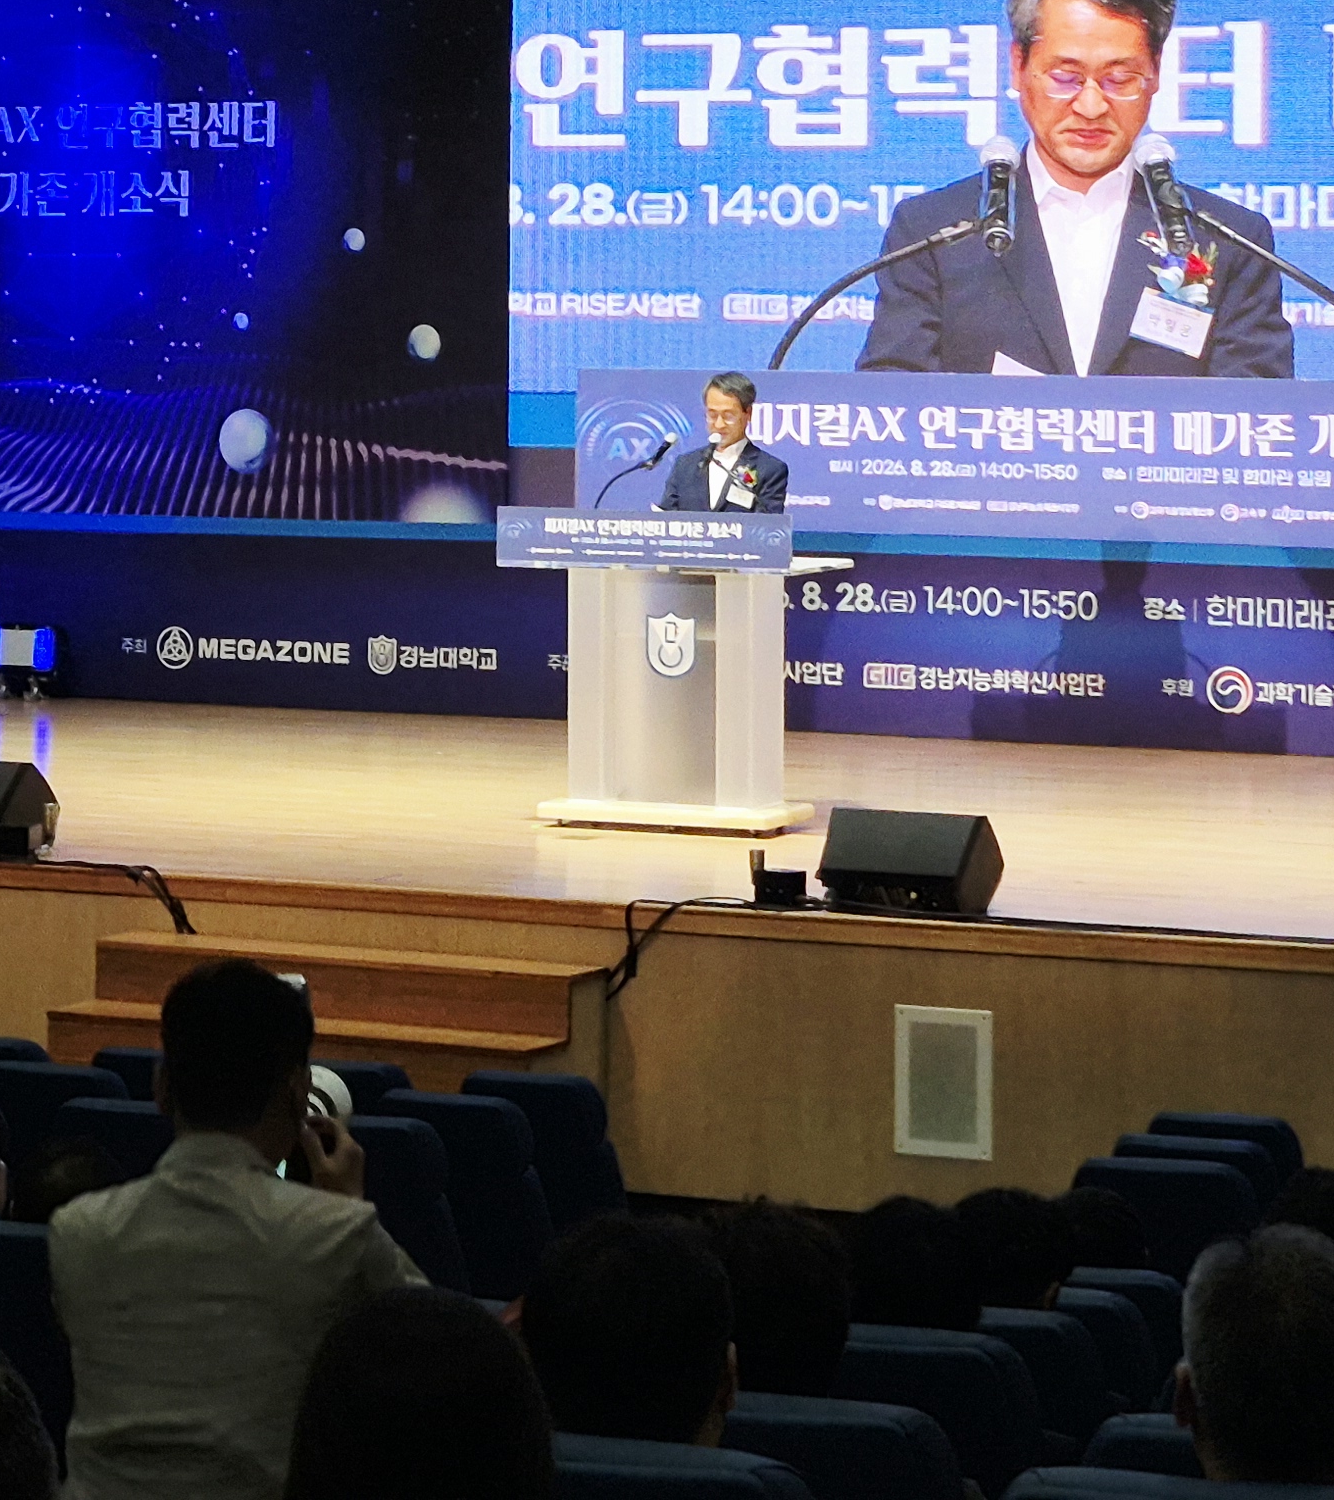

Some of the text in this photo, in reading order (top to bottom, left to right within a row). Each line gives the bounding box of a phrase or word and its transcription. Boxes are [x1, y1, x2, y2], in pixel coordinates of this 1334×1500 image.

[515, 24, 1267, 149] 연구협력터
[55, 99, 278, 151] 연구협력센터
[82, 168, 191, 217] 개소식
[548, 181, 689, 228] 28.(금)
[560, 291, 702, 319] RISE사업단
[747, 401, 907, 448] 피지컬AX
[918, 406, 1157, 455] 연구협력센터
[1172, 410, 1297, 458] 메가존
[606, 437, 653, 461] AX
[910, 460, 928, 477] 8.
[1136, 466, 1218, 485] 한마미래관
[1221, 467, 1240, 485] 및
[1242, 469, 1294, 487] 한마관
[1296, 469, 1332, 488] 일원
[801, 581, 829, 612] 8.
[835, 582, 916, 615] 28.(금)
[922, 585, 1099, 621] 14:00~15:50
[1143, 596, 1186, 621] 장소
[121, 637, 499, 671] 주최 MEGAZONE 경남대학교
[917, 666, 1106, 697] 경남지능화혁신사업단
[1161, 678, 1194, 698] 후원
